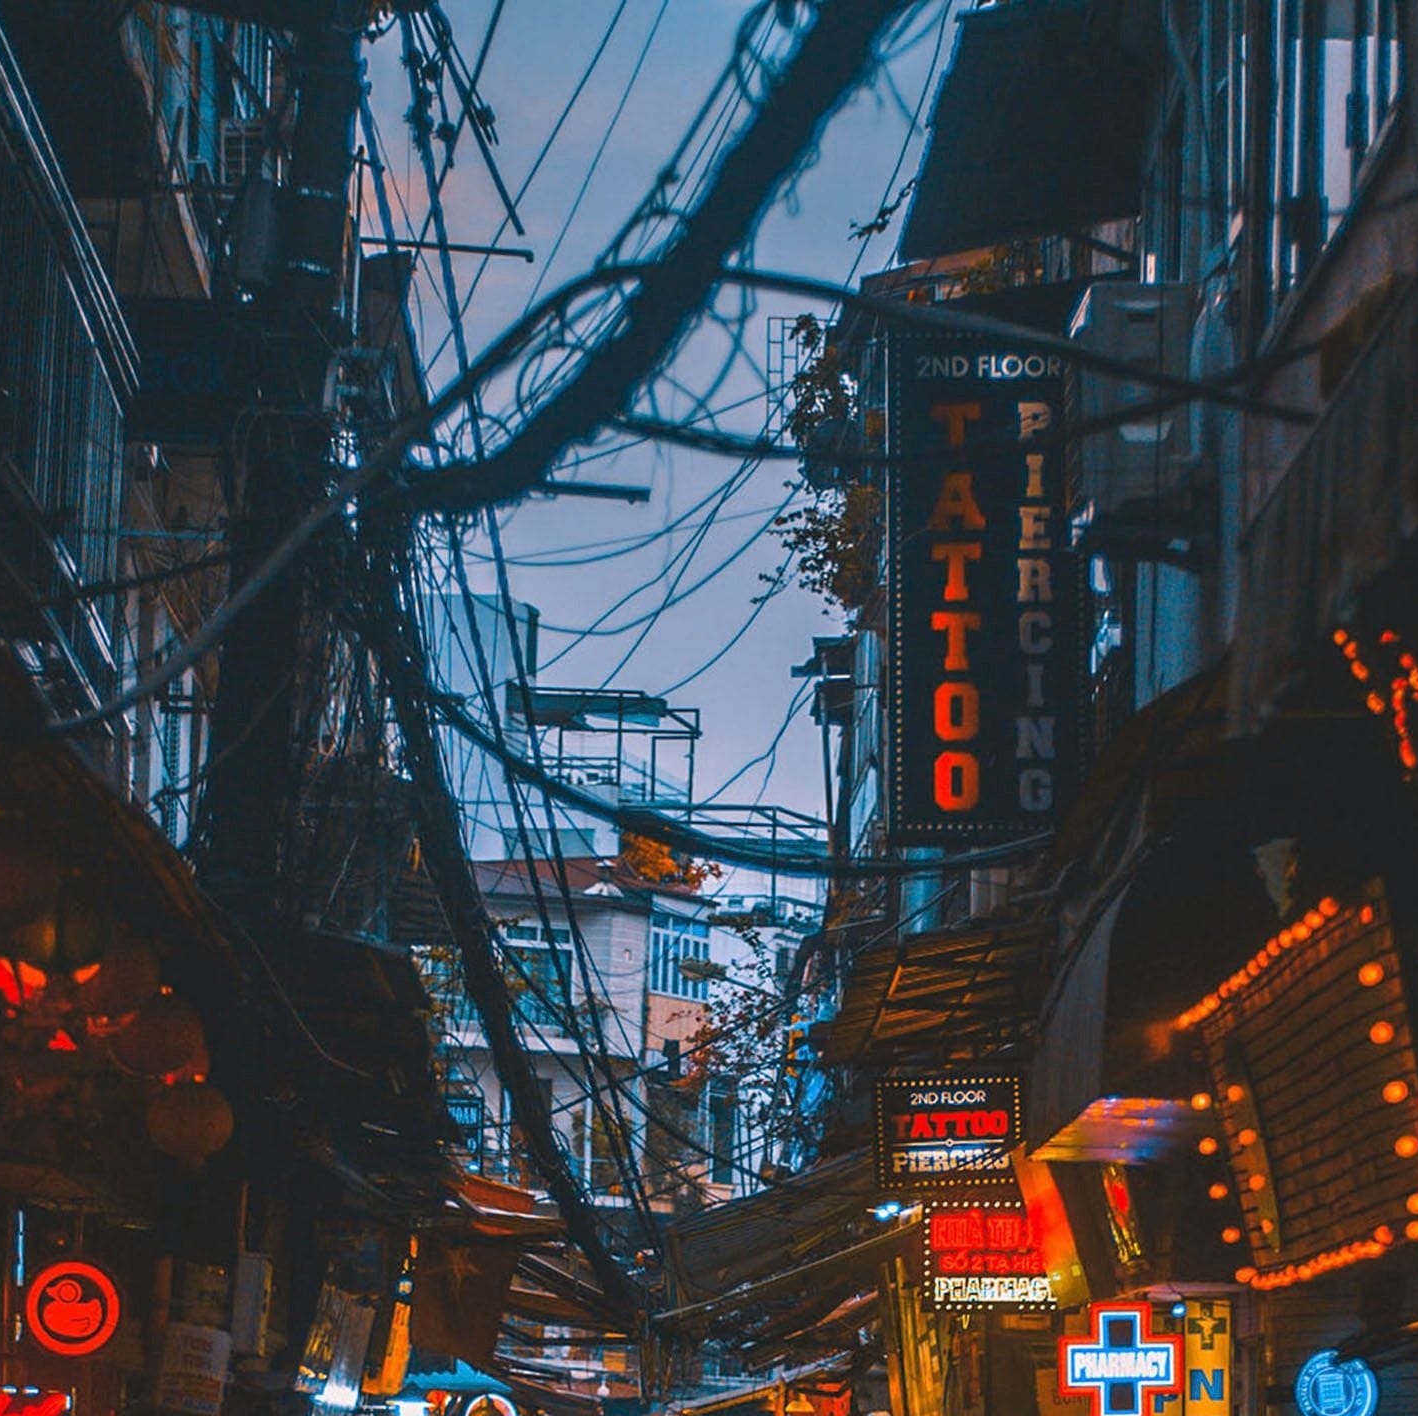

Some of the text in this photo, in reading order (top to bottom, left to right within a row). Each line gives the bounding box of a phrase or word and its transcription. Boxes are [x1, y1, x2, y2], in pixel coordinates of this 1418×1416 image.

[917, 354, 1061, 378] 2ND FLOOR
[929, 401, 986, 812] TATTOO
[1015, 401, 1057, 812] PIERCING
[910, 1089, 986, 1105] 2ND FLOOR
[892, 1110, 1008, 1138] TATTOO
[970, 1258, 982, 1271] 2
[1074, 1351, 1168, 1378] PHARMACY
